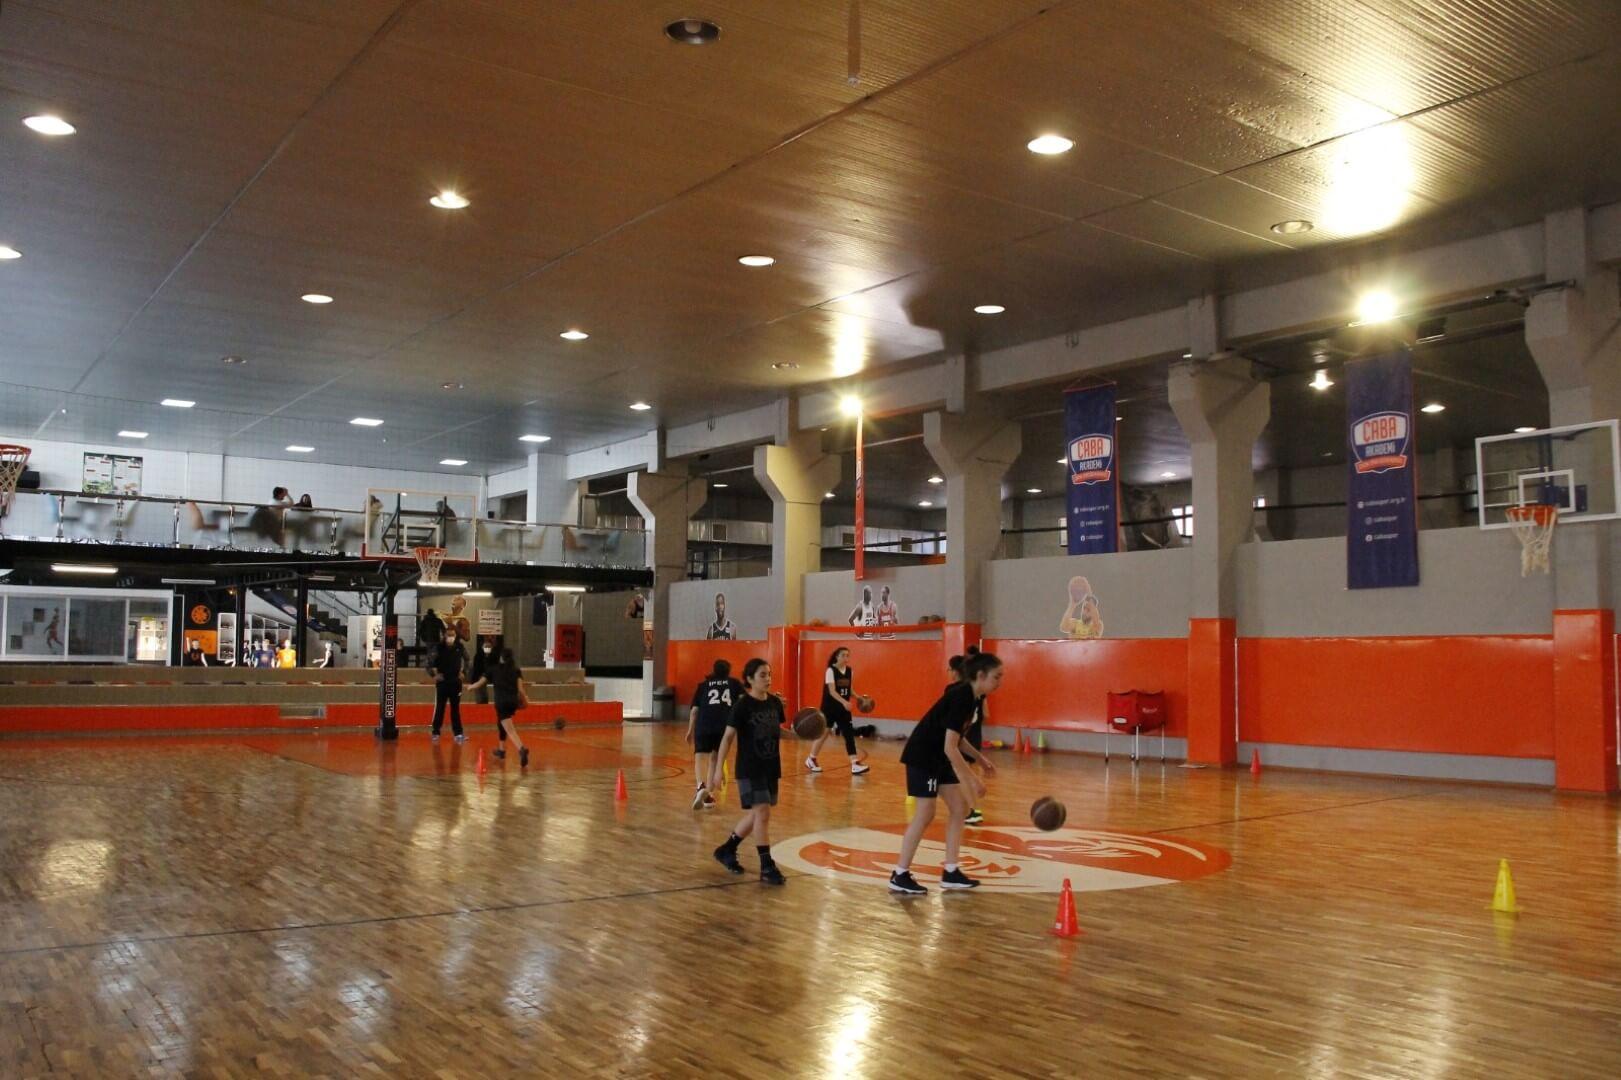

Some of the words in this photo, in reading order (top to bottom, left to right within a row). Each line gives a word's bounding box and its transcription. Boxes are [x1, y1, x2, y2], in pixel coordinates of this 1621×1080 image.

[1363, 416, 1396, 443] CABA
[1077, 438, 1103, 459] CABA
[707, 687, 732, 706] 24
[927, 778, 937, 792] 11
